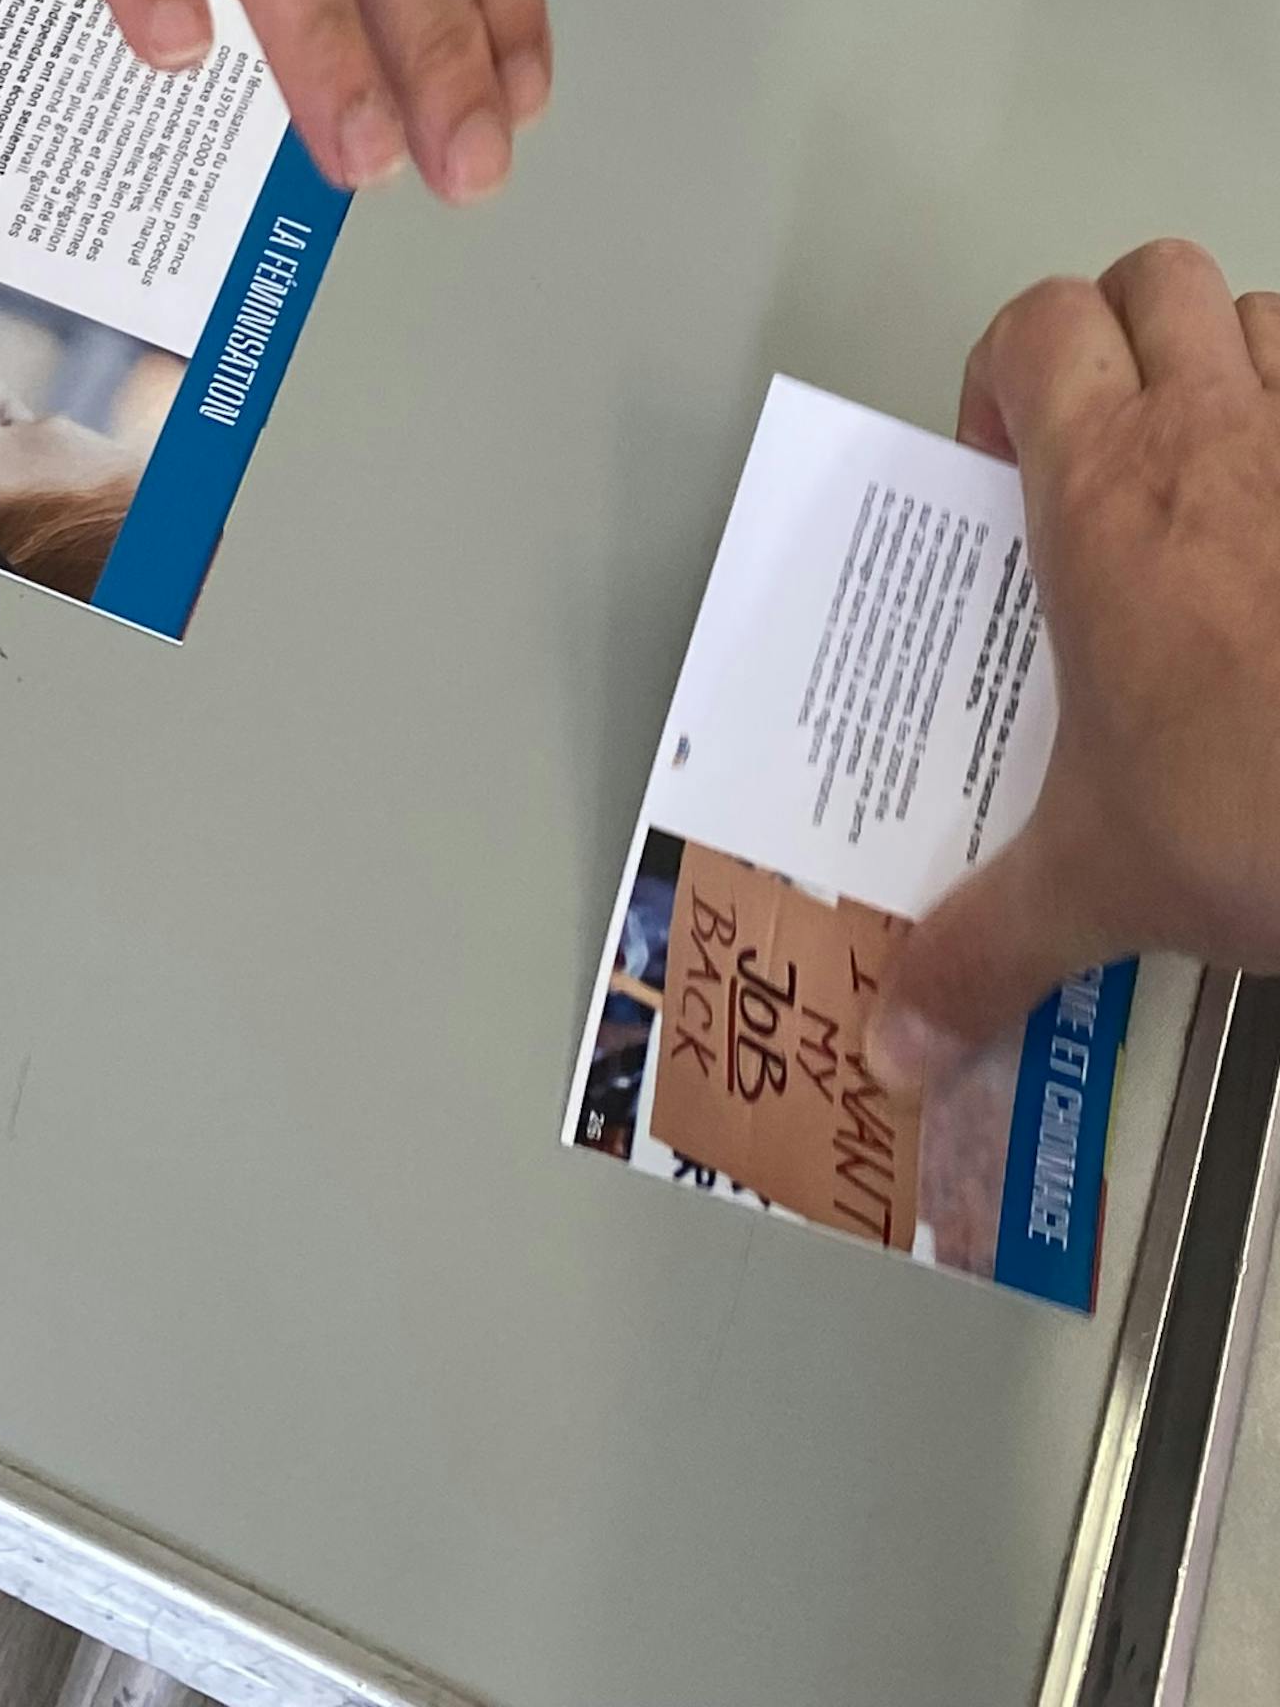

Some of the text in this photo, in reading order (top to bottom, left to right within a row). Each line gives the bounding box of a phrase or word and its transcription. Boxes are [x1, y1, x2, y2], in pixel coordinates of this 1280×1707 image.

[22, 4, 40, 27] ont
[48, 10, 83, 60] femmes
[5, 25, 30, 61] aussi
[25, 82, 45, 108] non
[37, 59, 56, 83] ont
[166, 58, 271, 276] La féminisation du travail en France
[198, 215, 312, 426] LA FÉMINISATION
[670, 884, 738, 1078] BACK
[797, 1004, 842, 1104] MY
[1049, 1036, 1090, 1086] ET
[833, 1053, 897, 1249] WANT
